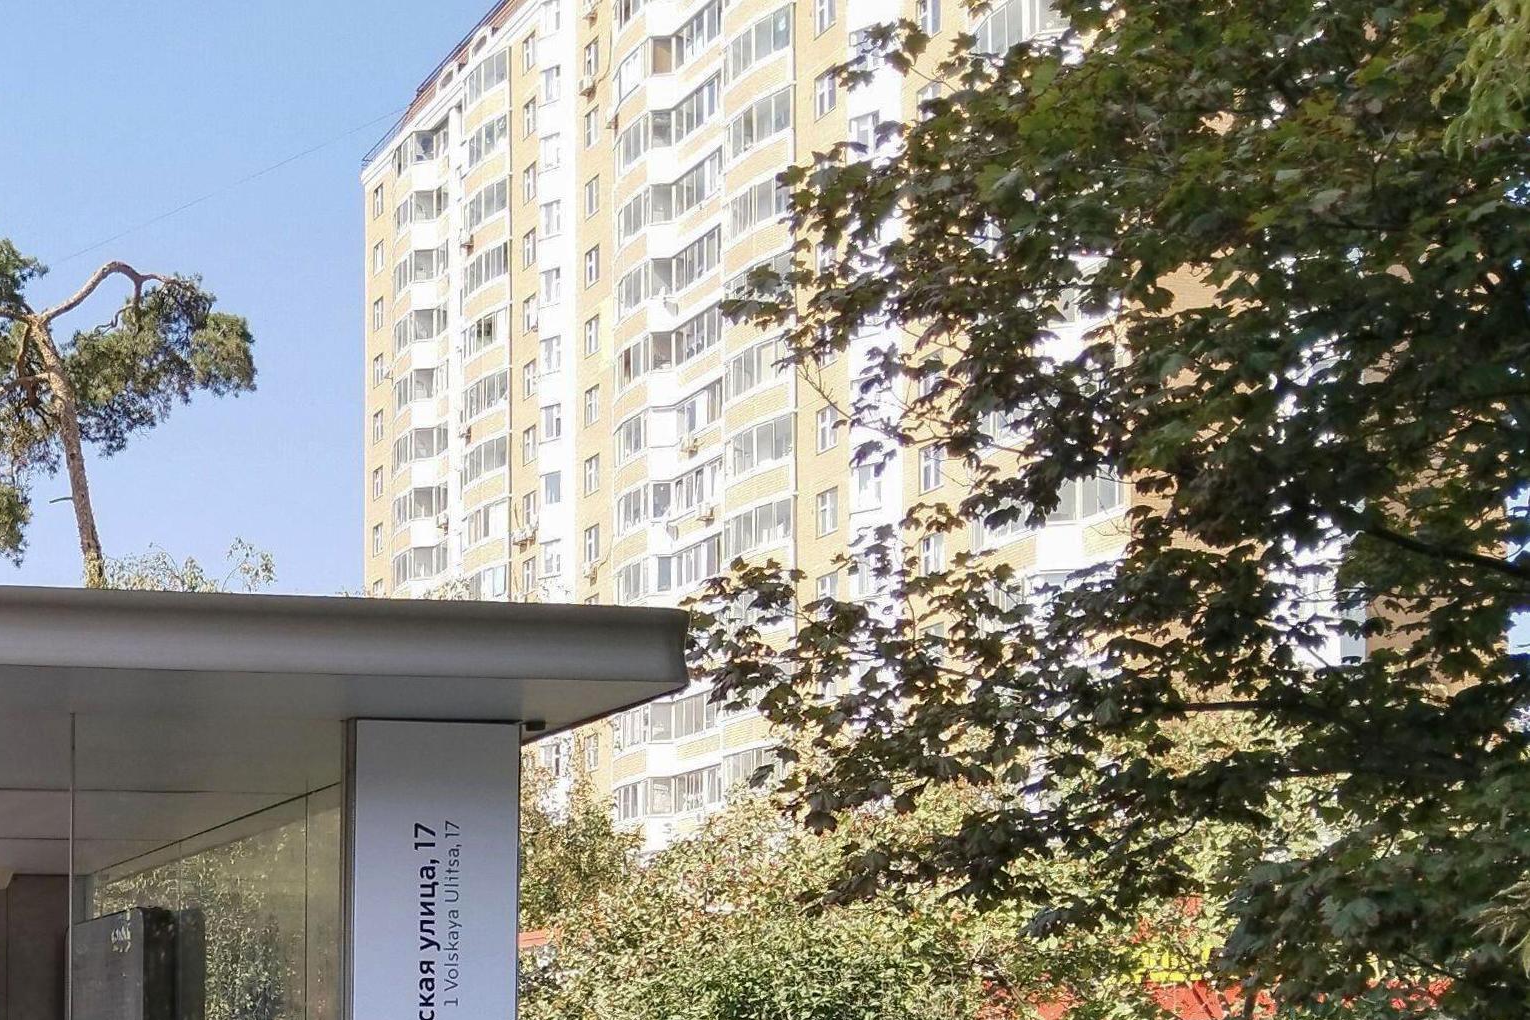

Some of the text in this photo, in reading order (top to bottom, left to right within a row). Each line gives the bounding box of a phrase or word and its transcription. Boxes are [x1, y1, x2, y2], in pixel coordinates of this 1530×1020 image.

[414, 822, 436, 851] 17
[419, 858, 440, 951] улица,
[443, 820, 462, 1007] 1 Volskaya Ulitsa, 17
